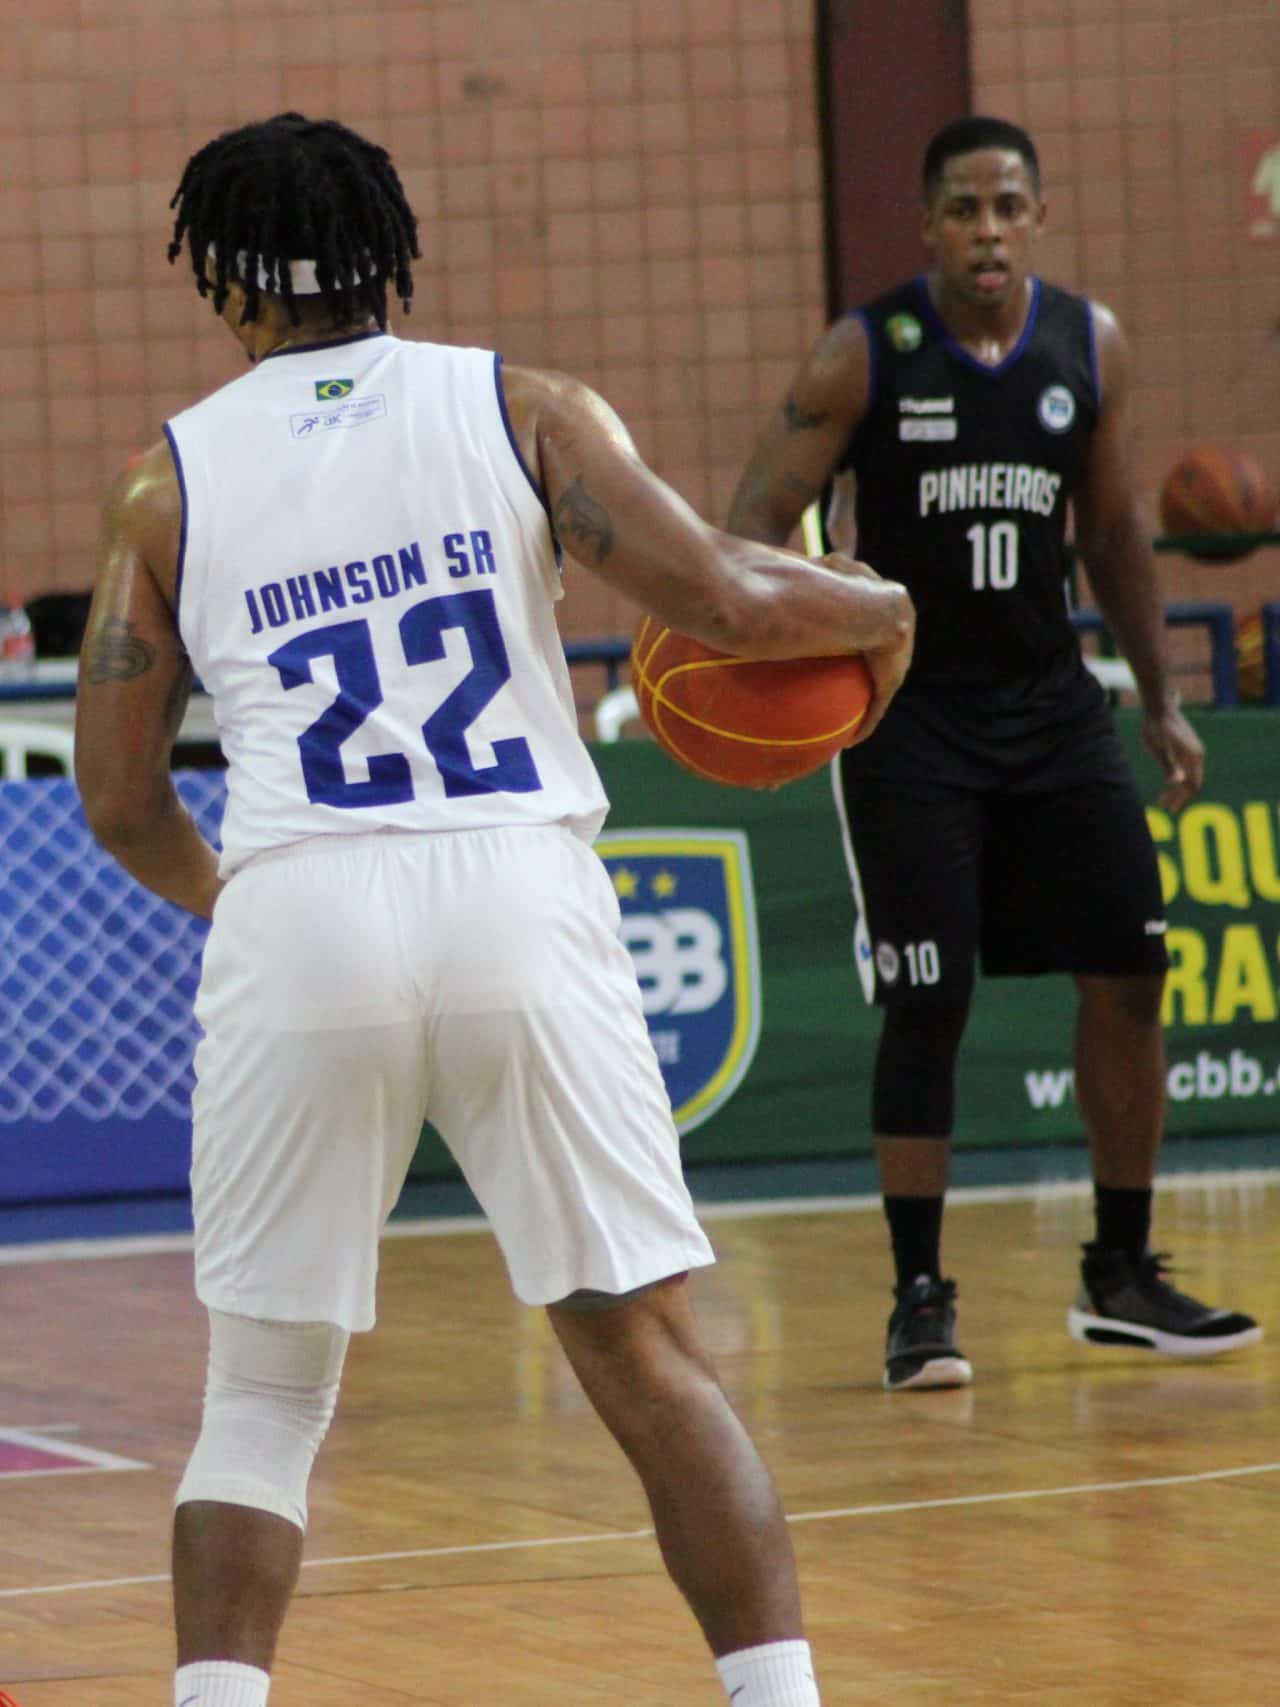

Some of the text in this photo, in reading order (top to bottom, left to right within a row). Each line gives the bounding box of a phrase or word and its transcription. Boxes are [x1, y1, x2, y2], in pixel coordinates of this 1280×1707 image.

[920, 463, 1061, 518] PINHEIROS
[244, 529, 497, 635] JOHNSON SR
[966, 521, 1019, 591] 10
[267, 588, 544, 809] 22
[617, 907, 728, 1016] BB
[903, 940, 940, 987] 10
[1159, 922, 1280, 1027] RA
